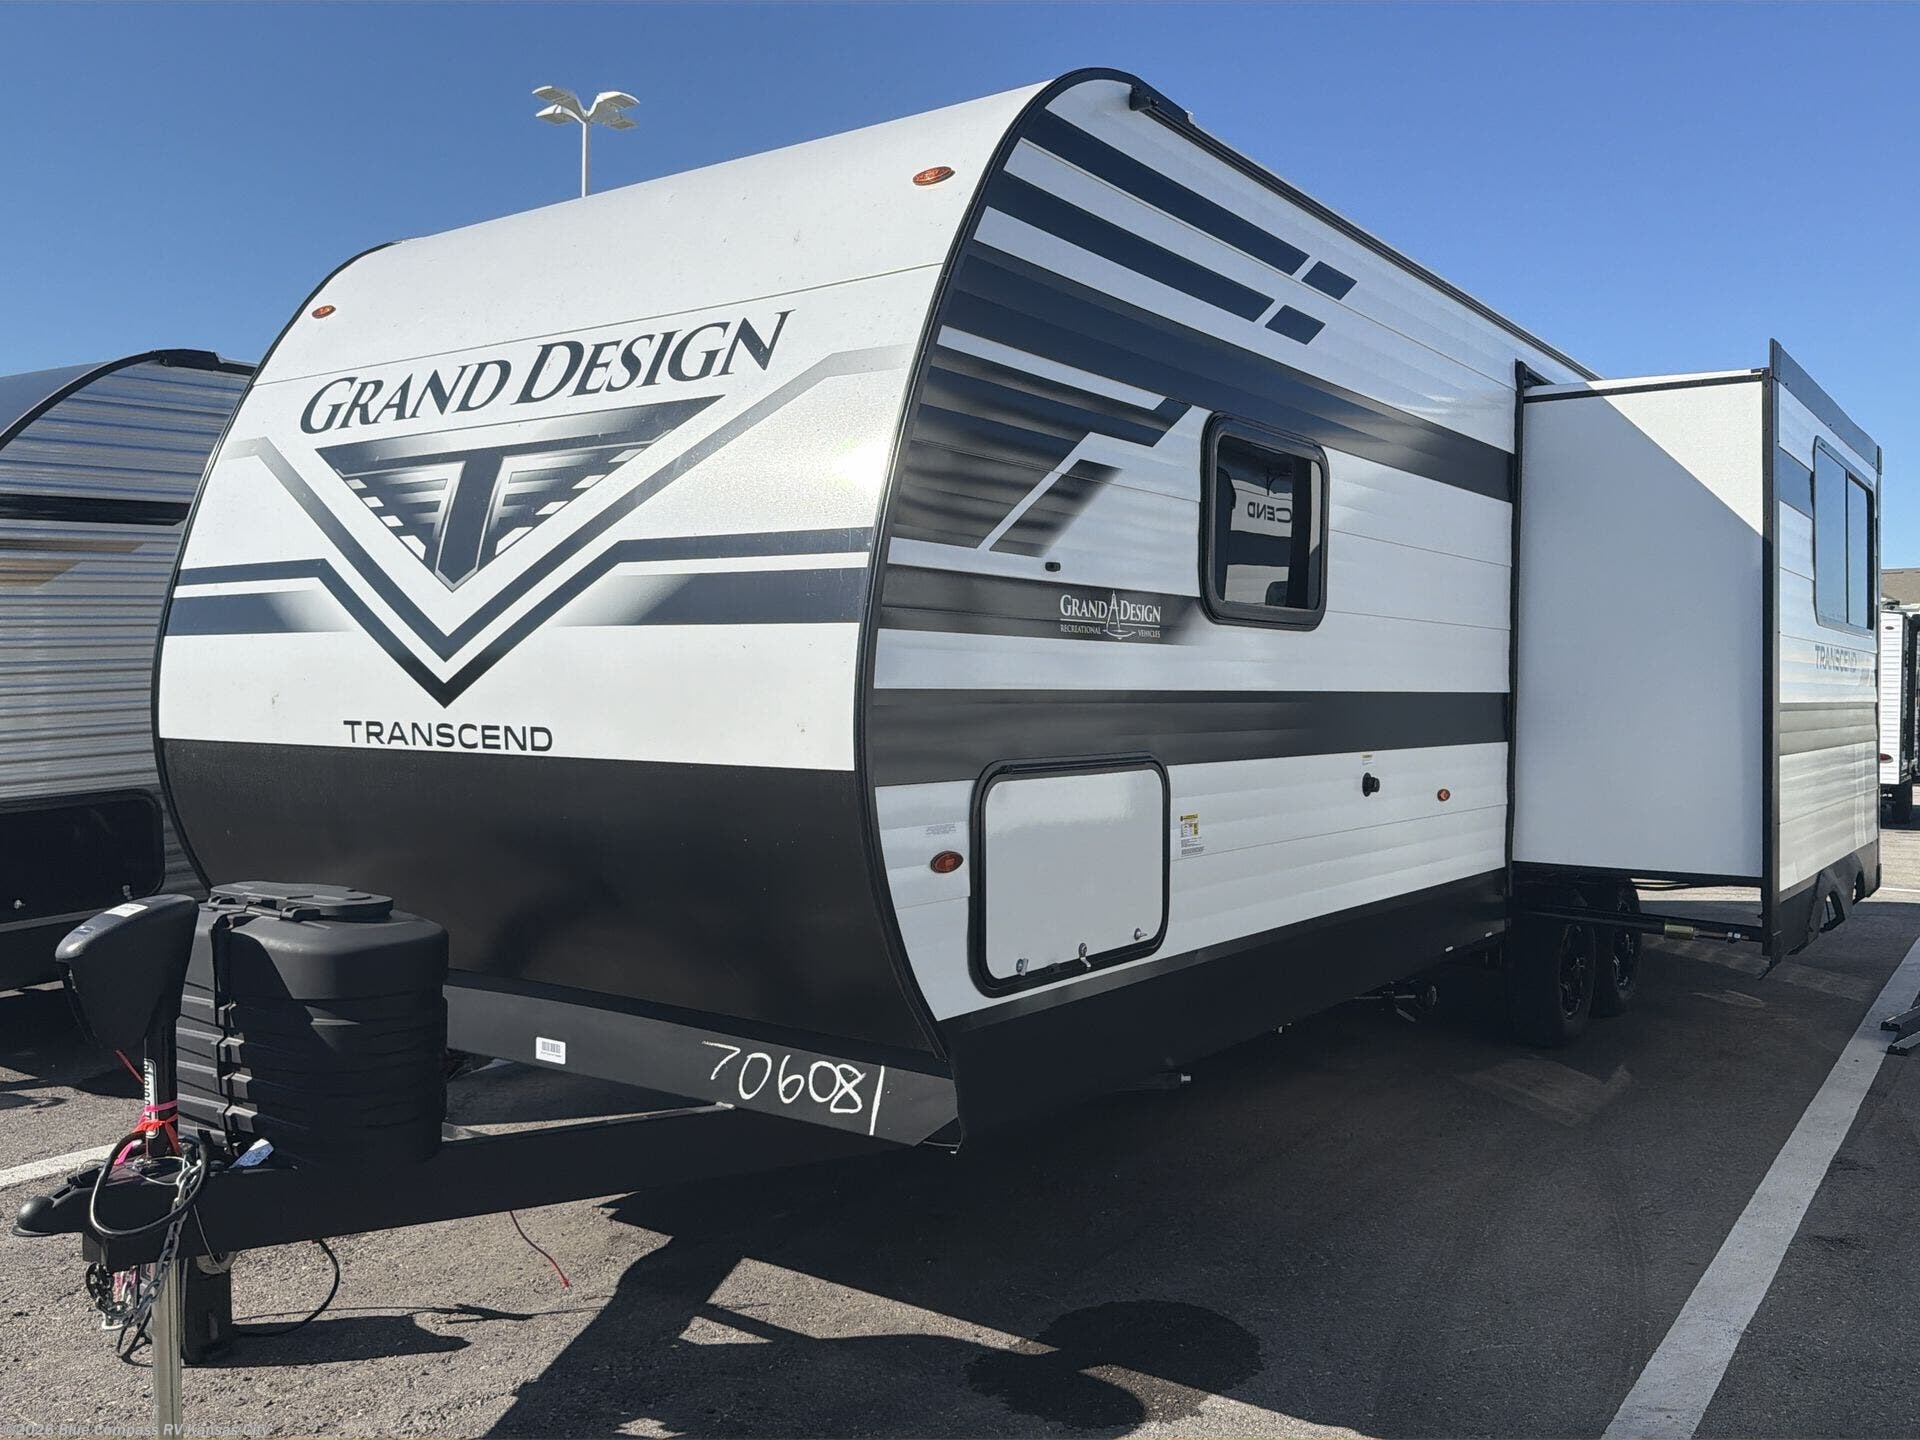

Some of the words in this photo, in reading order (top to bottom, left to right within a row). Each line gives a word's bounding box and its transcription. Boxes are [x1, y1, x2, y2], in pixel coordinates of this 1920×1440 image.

[300, 359, 512, 435] GRAND
[511, 309, 797, 406] DESIGN
[1059, 594, 1108, 619] GRAND
[1119, 599, 1162, 623] DESIGN
[1060, 624, 1102, 635] RECREATIONAL
[1138, 629, 1161, 639] VEHICLES
[343, 720, 553, 752] TRANSCEND
